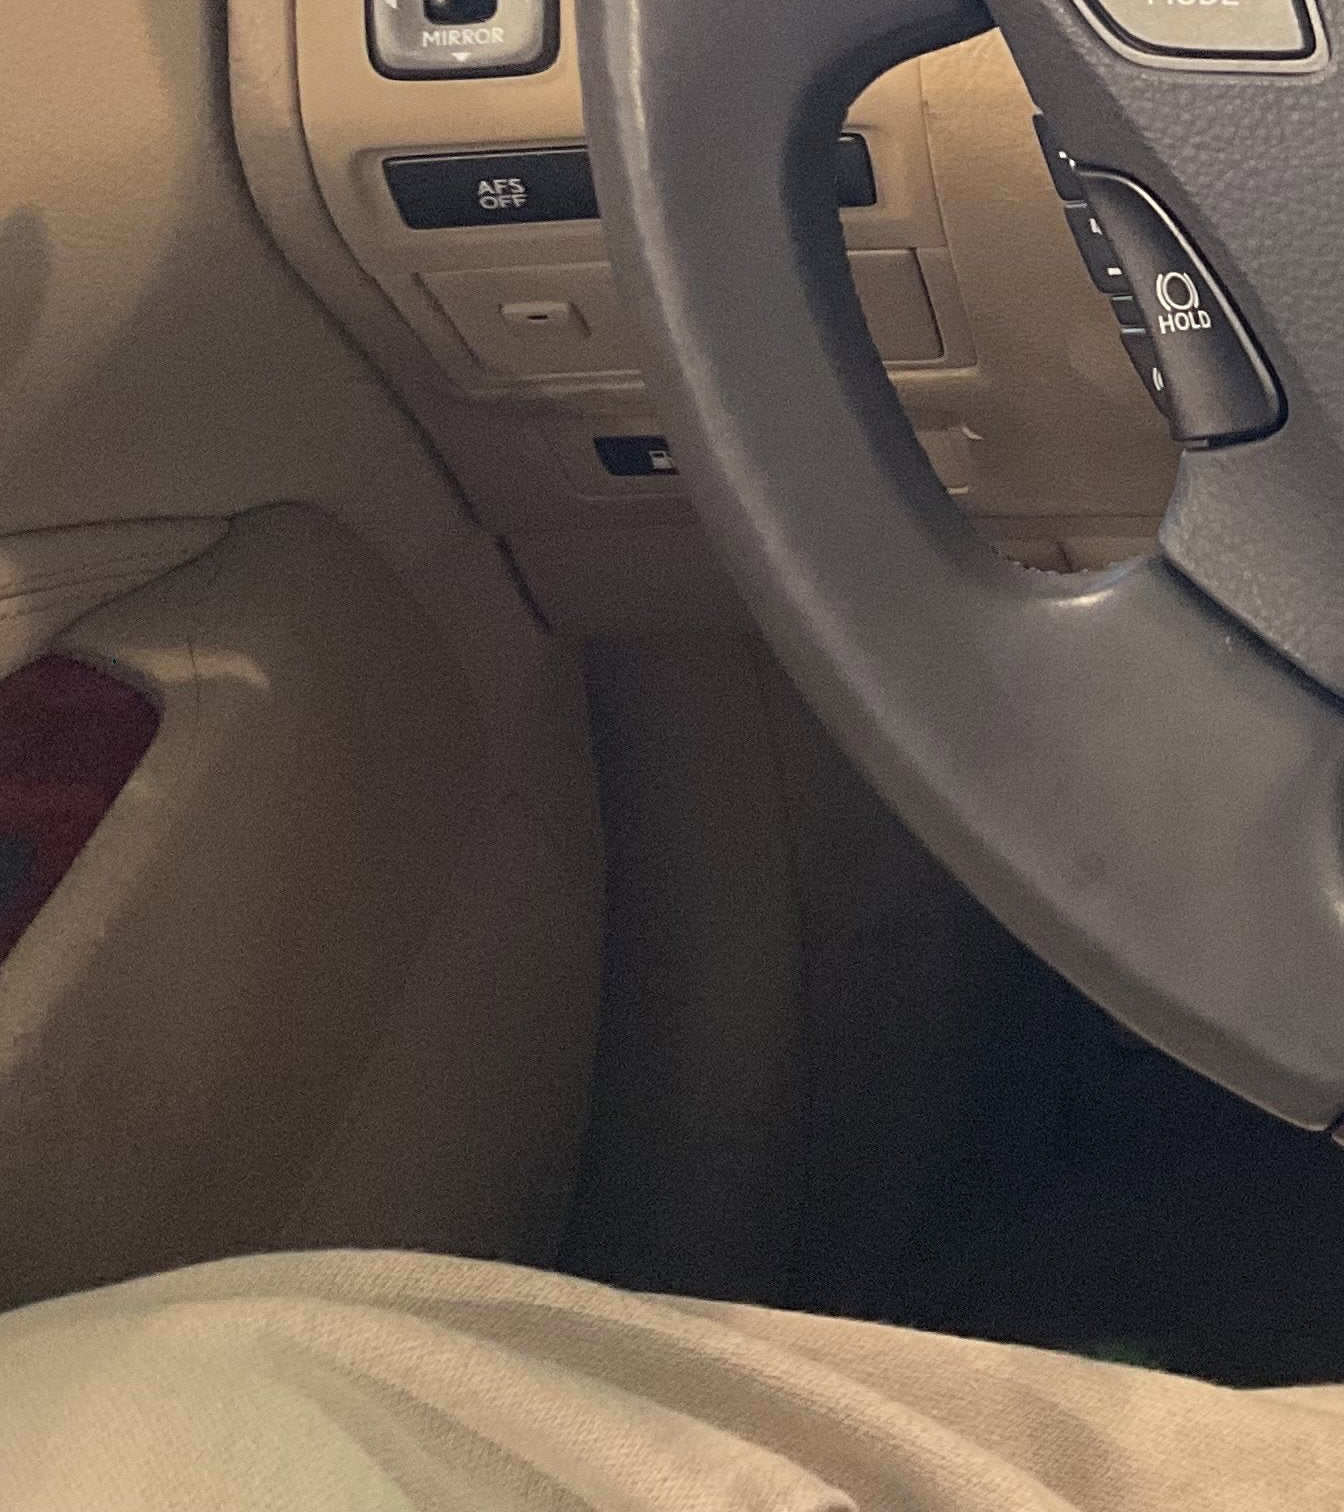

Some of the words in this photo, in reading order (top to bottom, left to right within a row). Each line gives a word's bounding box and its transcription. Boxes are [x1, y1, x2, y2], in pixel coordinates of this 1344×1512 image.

[421, 26, 505, 47] MIRROR
[478, 178, 525, 194] AFS
[479, 194, 527, 209] OFF
[1158, 310, 1211, 334] HOLD
